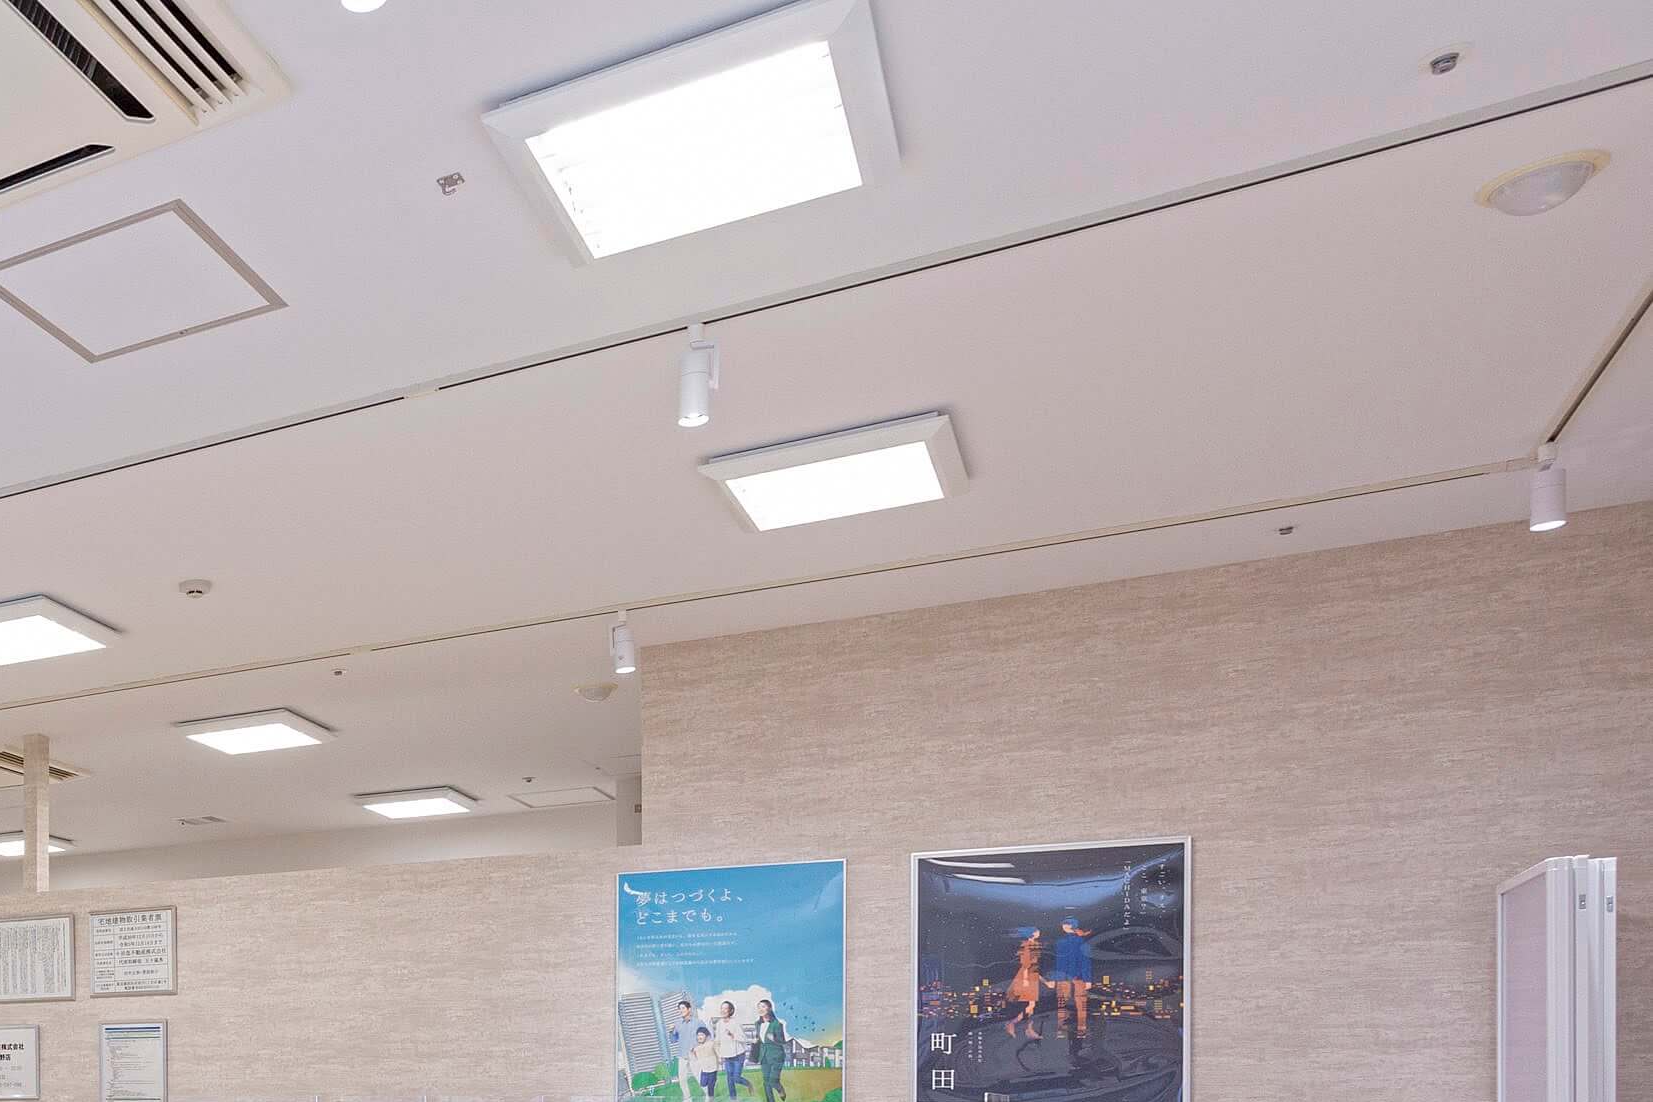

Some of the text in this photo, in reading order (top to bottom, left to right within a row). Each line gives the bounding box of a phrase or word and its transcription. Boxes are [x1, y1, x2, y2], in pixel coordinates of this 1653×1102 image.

[634, 887, 744, 907] 夢はつづくよ、
[97, 913, 162, 926] 宅地建物取引業者票
[636, 908, 725, 926] どこまでも。
[931, 1032, 957, 1091] 町田
